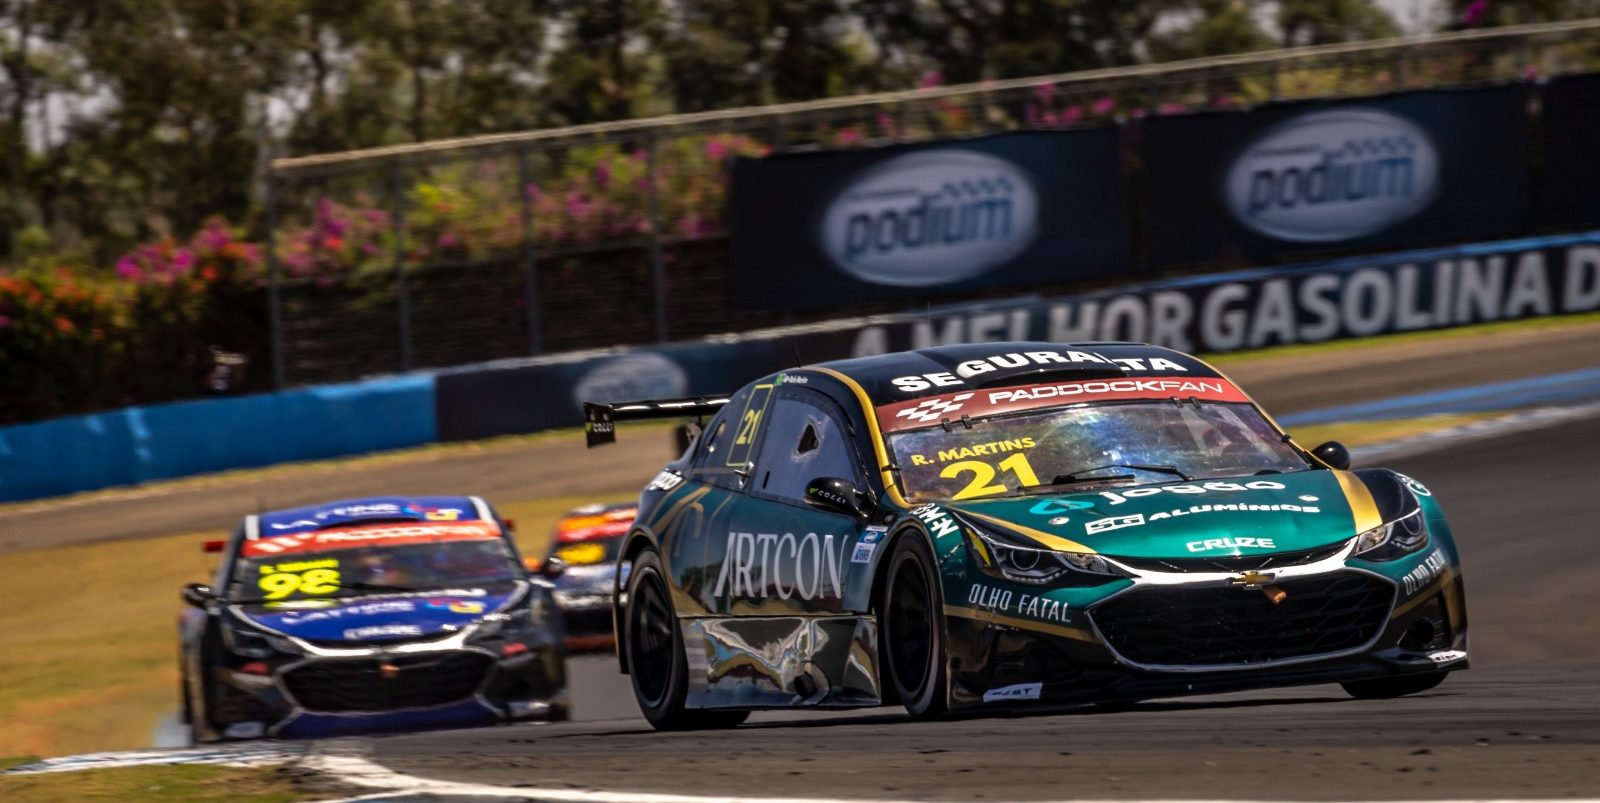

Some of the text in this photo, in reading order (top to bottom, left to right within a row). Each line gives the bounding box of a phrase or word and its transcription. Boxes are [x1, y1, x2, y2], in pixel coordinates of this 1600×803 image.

[1247, 152, 1414, 217] podium
[842, 195, 1013, 261] podium
[1202, 250, 1552, 352] GASOLINA
[891, 350, 1188, 392] SEGURALTA
[988, 380, 1223, 404] PADDOCKFAN
[735, 409, 762, 445] 21
[911, 437, 1036, 466] R. MARTINS
[939, 452, 1041, 501] 21
[1185, 536, 1277, 553] CRUZE
[257, 568, 342, 600] 98
[713, 531, 849, 600] ARTCON
[968, 583, 1072, 623] OLHO FATAL
